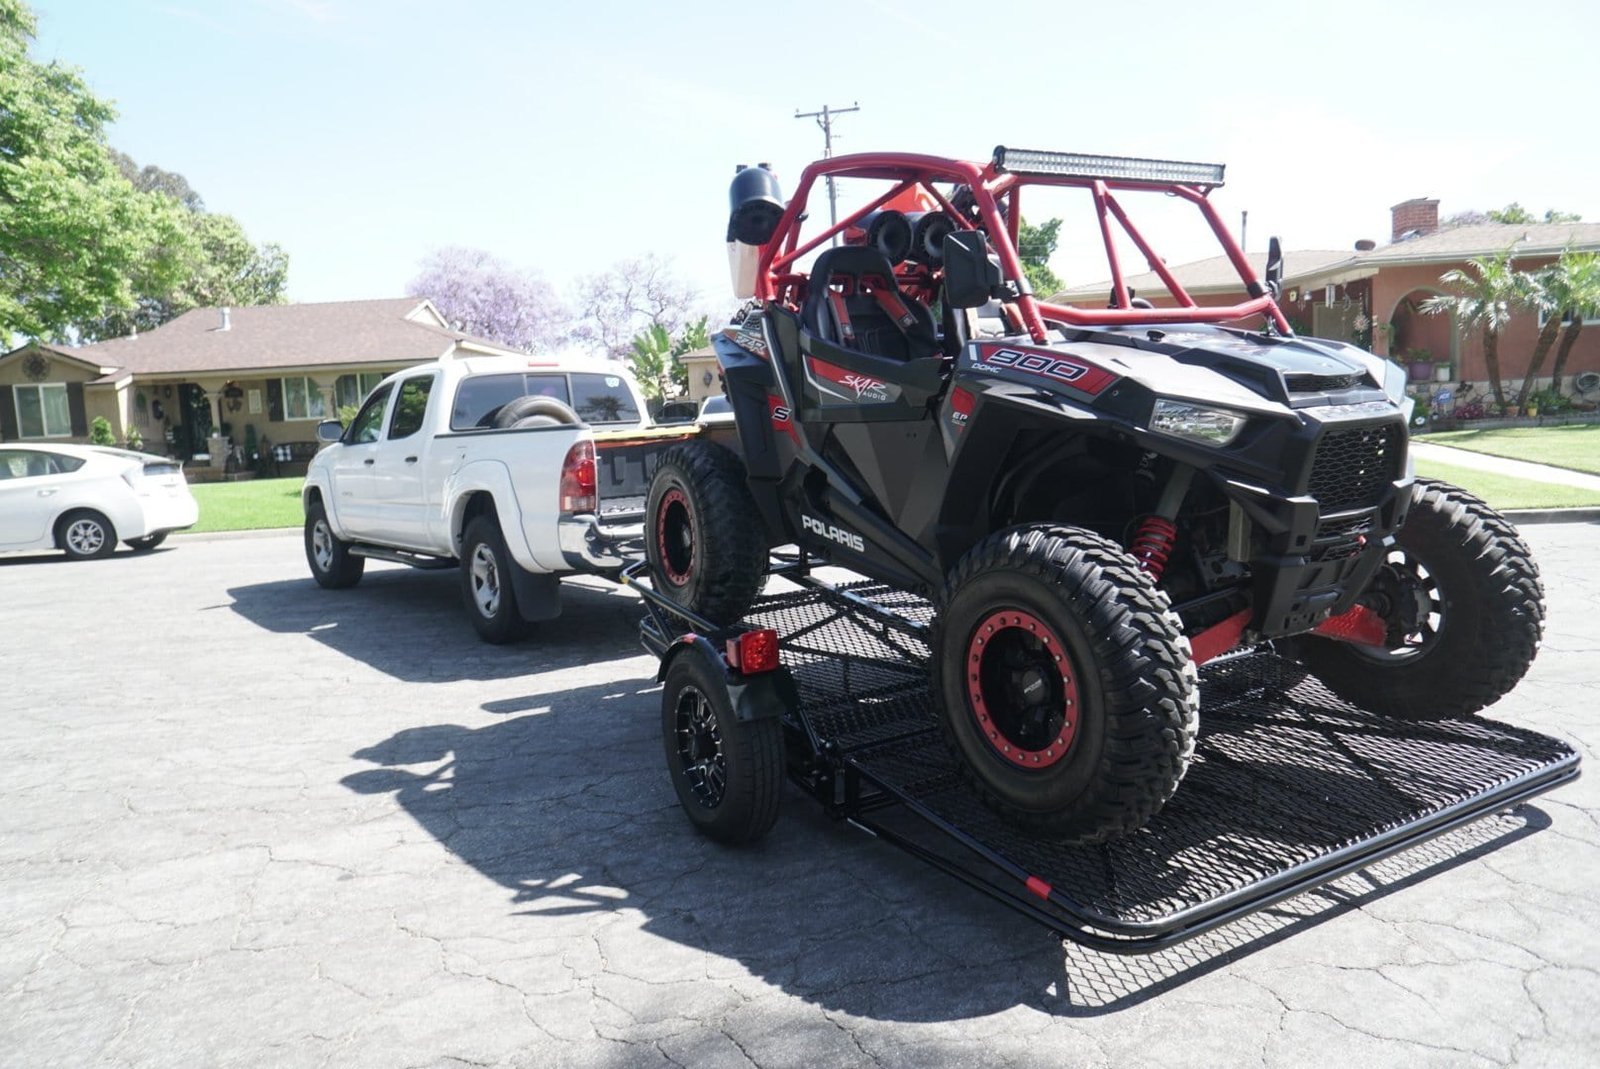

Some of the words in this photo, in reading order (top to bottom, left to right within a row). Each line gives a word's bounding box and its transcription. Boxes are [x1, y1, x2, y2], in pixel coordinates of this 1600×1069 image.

[987, 348, 1089, 382] 900
[837, 375, 888, 399] SKAR
[862, 391, 887, 401] AUDIO
[771, 406, 792, 422] S
[801, 514, 865, 552] POLARIS
